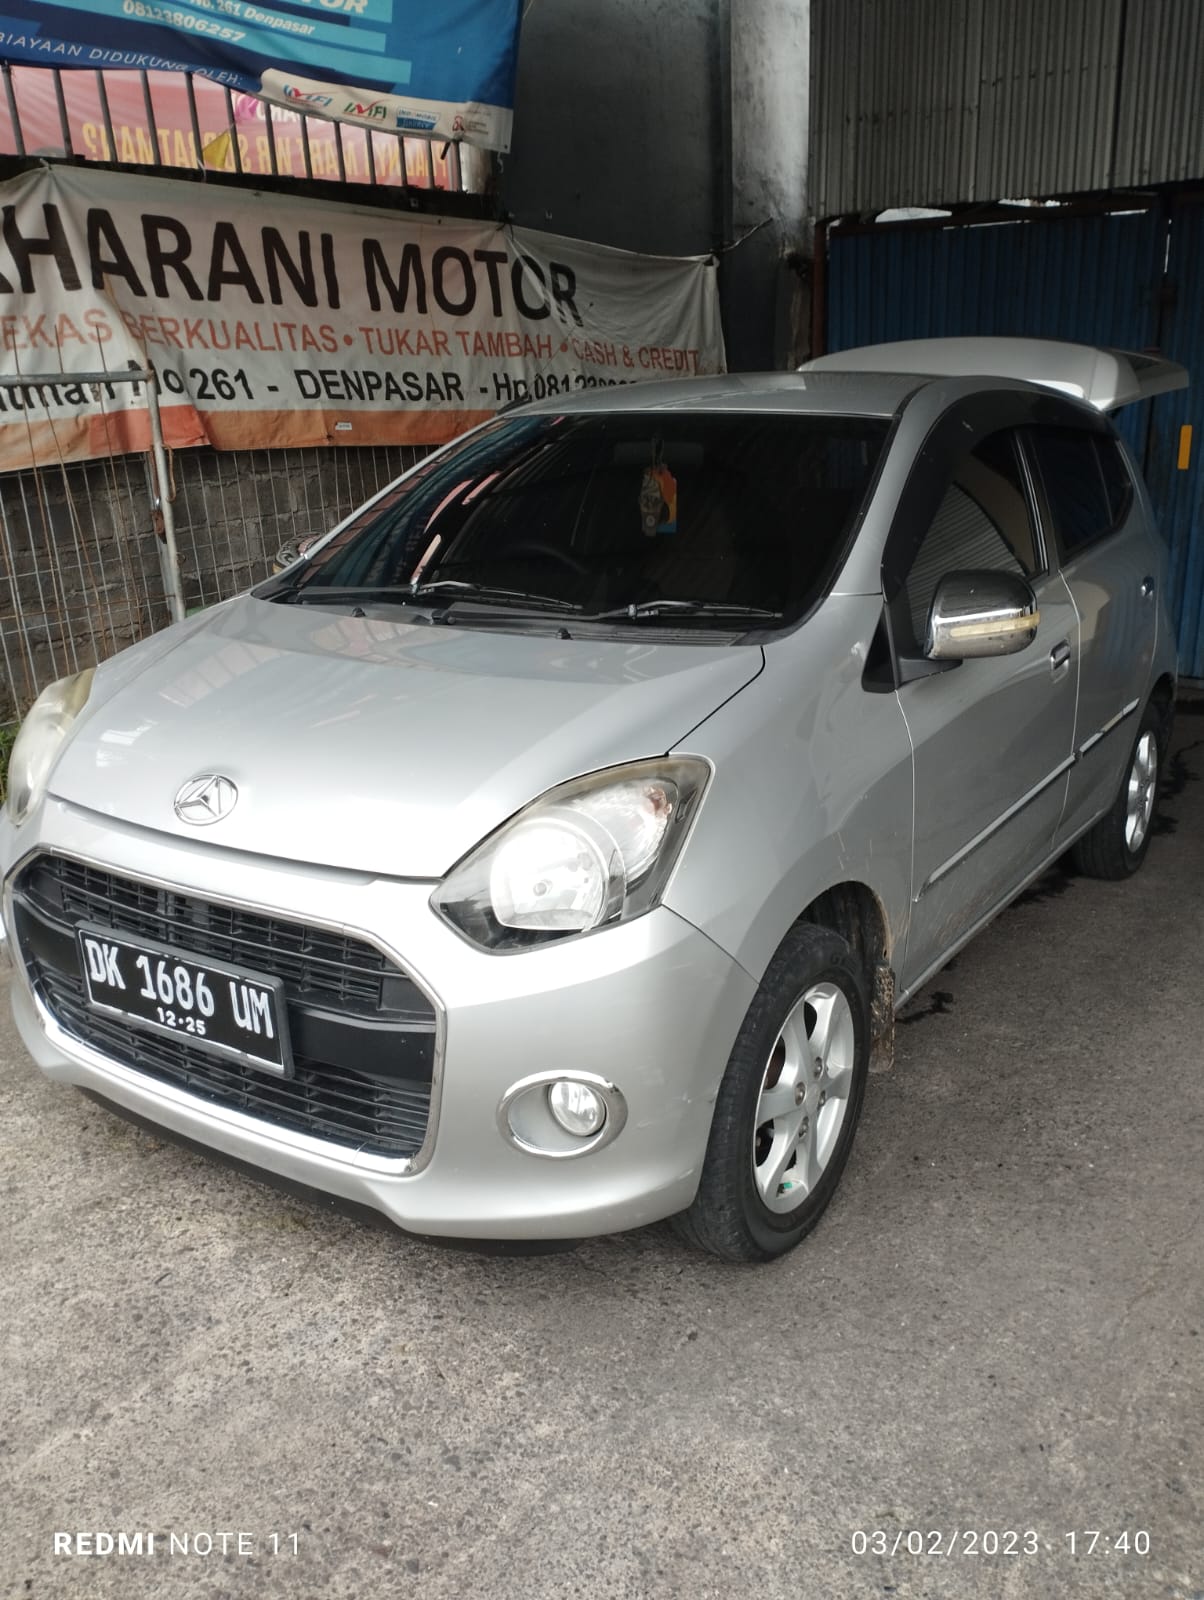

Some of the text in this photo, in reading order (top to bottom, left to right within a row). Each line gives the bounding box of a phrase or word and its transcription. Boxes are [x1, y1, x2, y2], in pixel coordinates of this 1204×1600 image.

[243, 7, 316, 36] Denpasar
[0, 202, 585, 327] HARANI MOTOR
[120, 313, 339, 354] BERKUALITAS
[359, 326, 449, 358] TUKAR
[456, 329, 553, 360] TAMBAH
[573, 338, 617, 367] CASH
[622, 348, 635, 368] &
[638, 348, 699, 374] CREDIT
[189, 368, 254, 401] 261
[294, 369, 464, 403] DENPASAR
[85, 938, 274, 1039] DK 1686 UM
